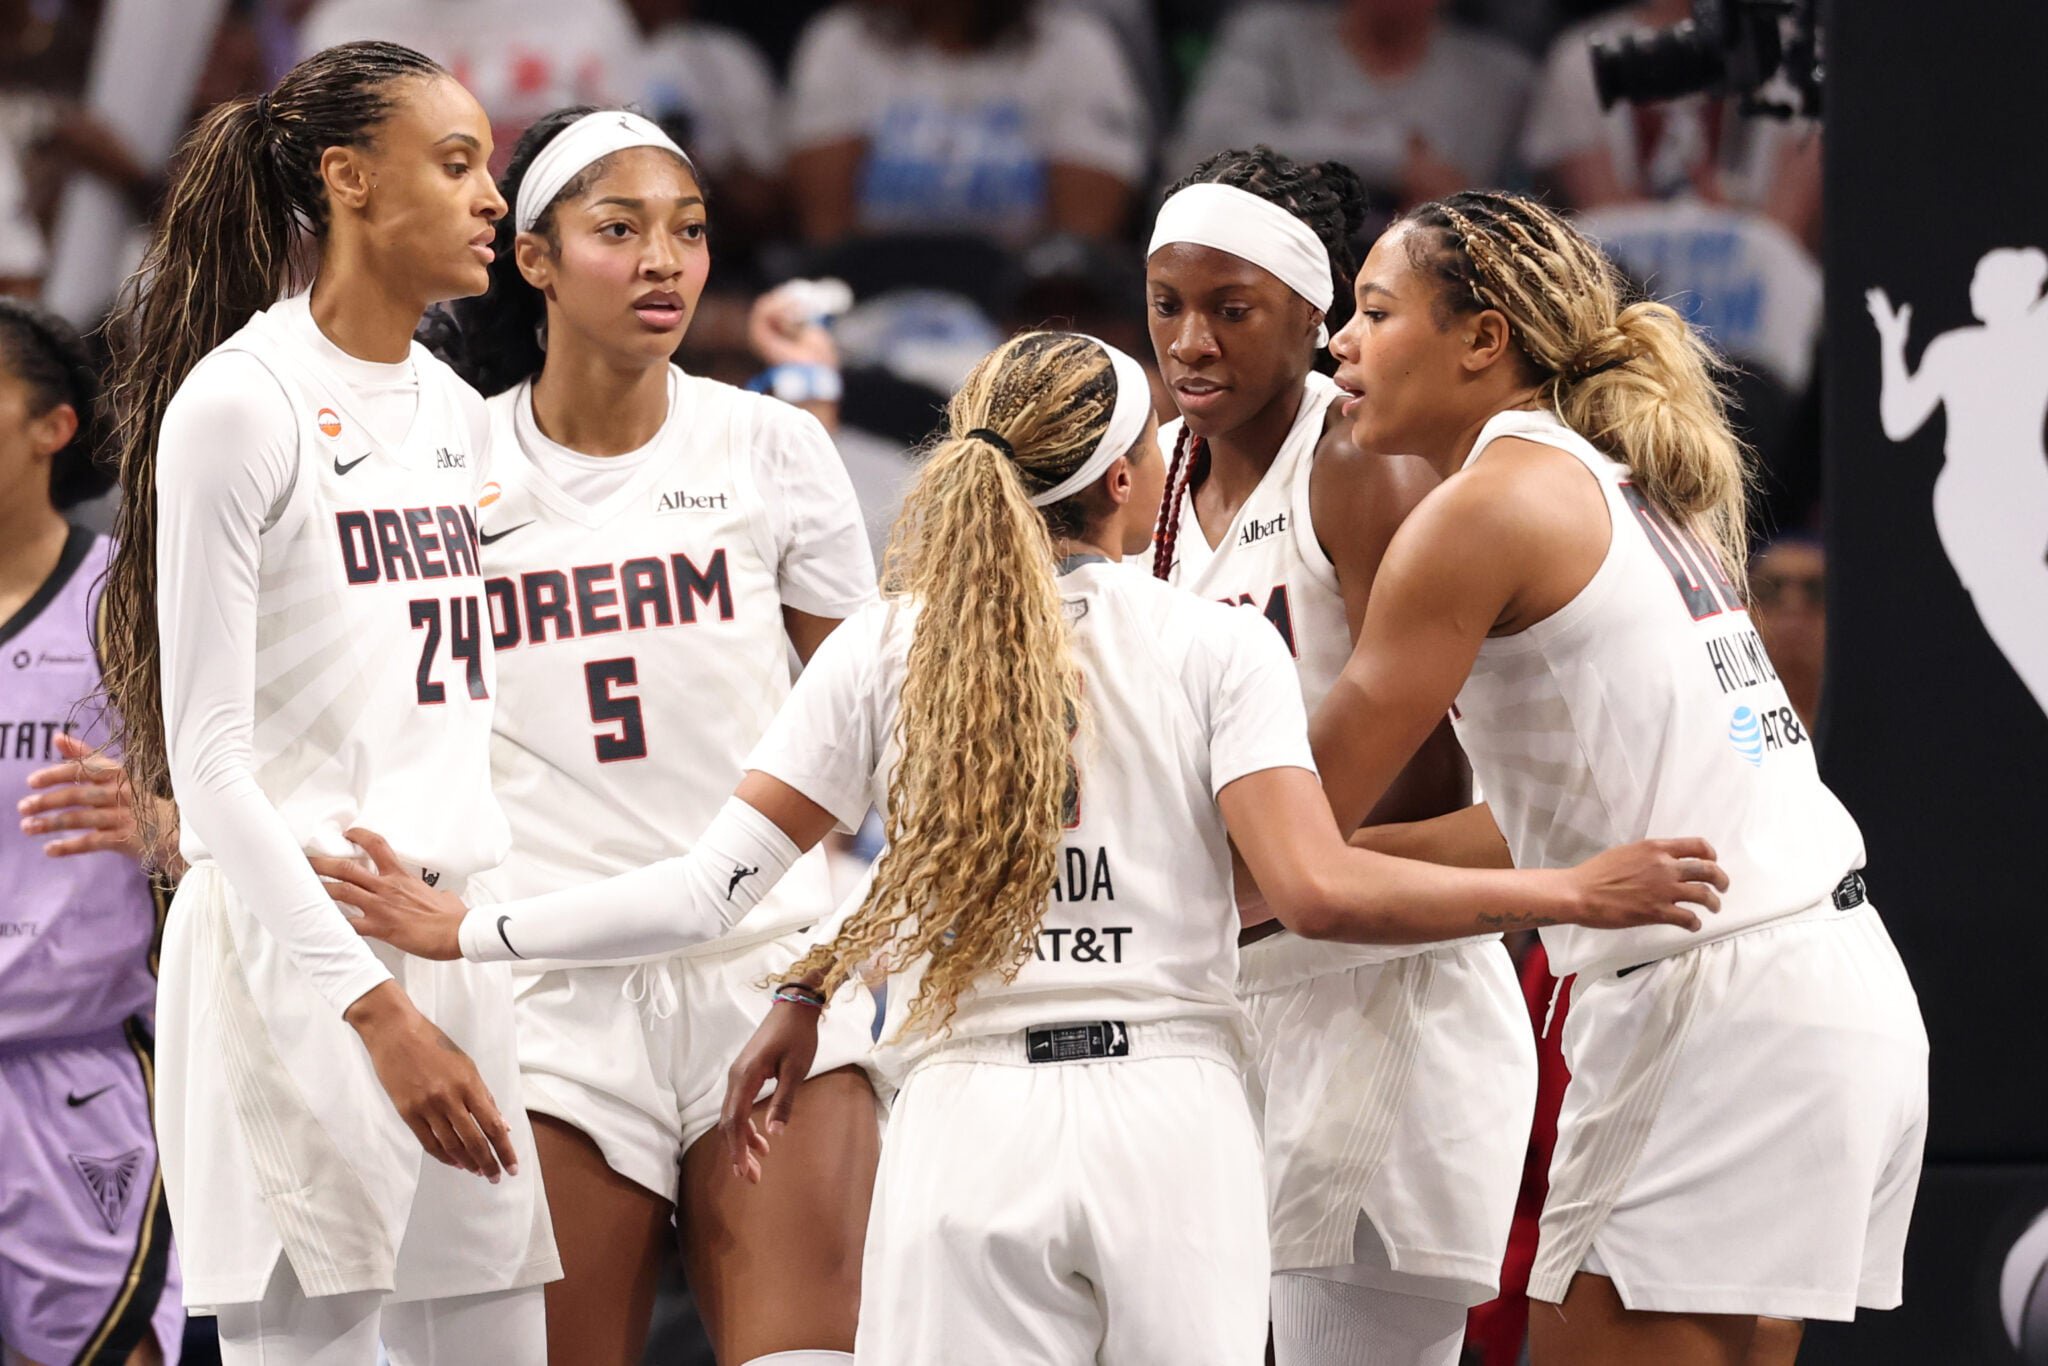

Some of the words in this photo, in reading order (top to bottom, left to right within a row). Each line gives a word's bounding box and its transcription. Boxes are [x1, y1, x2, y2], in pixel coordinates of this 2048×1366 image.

[436, 447, 467, 469] Alber
[657, 491, 728, 511] Albert
[1238, 513, 1286, 546] Albert
[484, 548, 735, 651] DREAM
[409, 596, 490, 705] 24
[583, 656, 648, 764] 5
[1761, 706, 1807, 751] AT&
